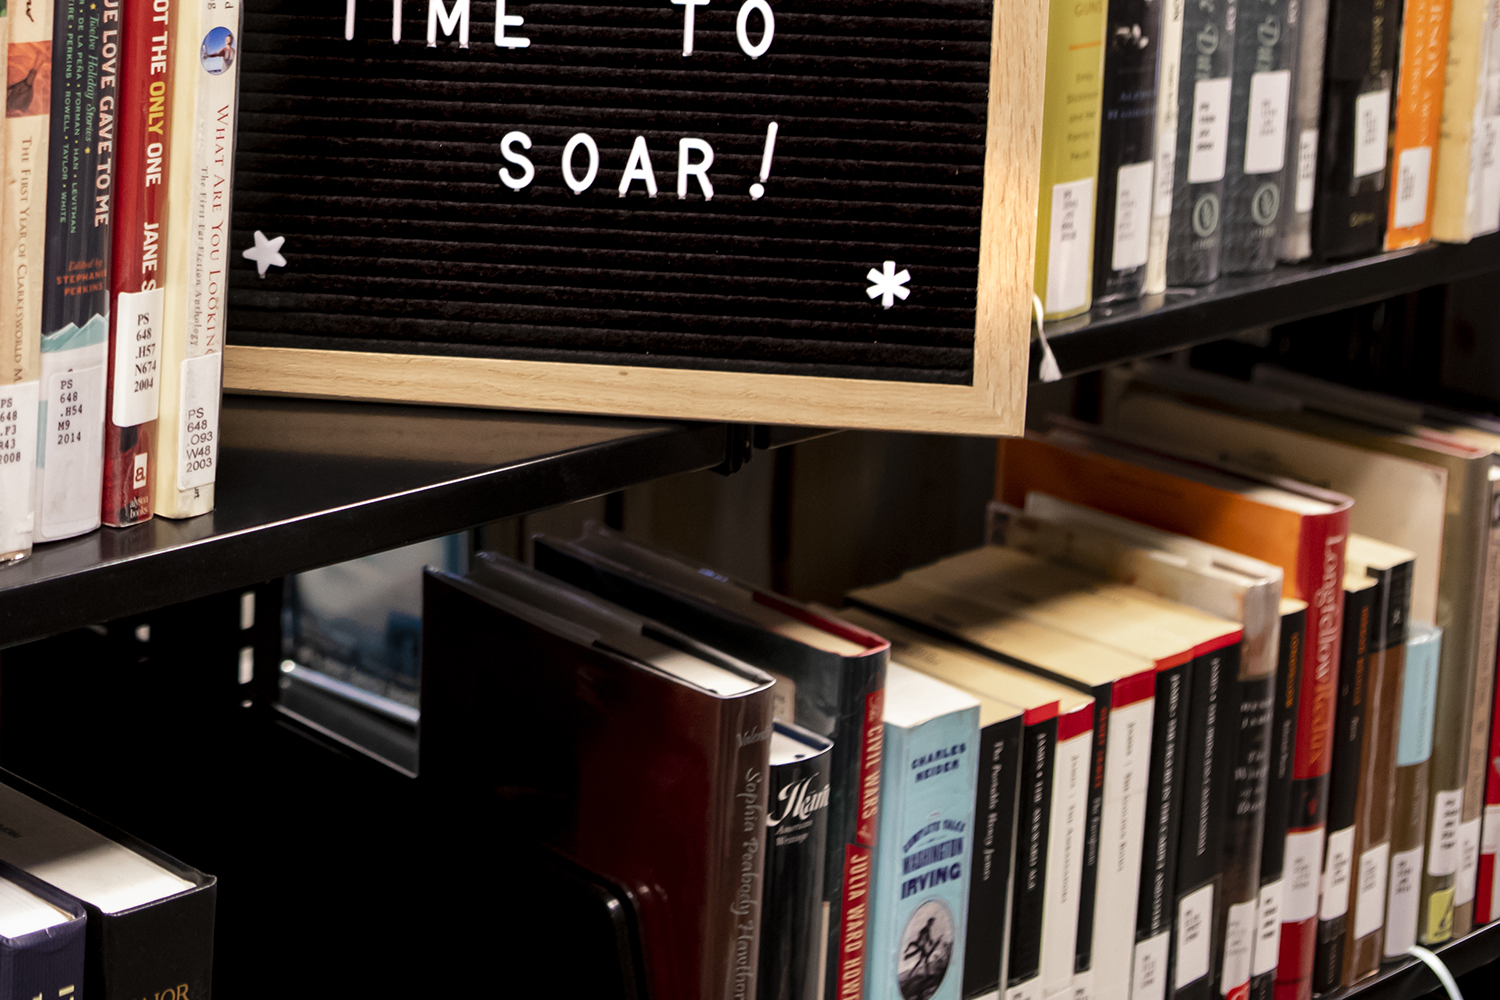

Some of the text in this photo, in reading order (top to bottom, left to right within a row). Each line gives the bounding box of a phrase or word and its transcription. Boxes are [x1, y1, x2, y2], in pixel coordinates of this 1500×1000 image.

[77, 17, 84, 31] DE
[65, 33, 74, 78] PERKINS
[77, 35, 84, 49] LA
[150, 31, 167, 75] THE
[76, 52, 84, 81] PEÑA
[100, 29, 117, 89] LOVE
[84, 13, 100, 142] Twelve Holiday Stories
[63, 91, 71, 133] ROWELL
[148, 81, 165, 135] ONLY
[97, 95, 115, 155] GAVE
[214, 104, 229, 166] WHAT
[61, 144, 69, 180] TAYLOR
[96, 160, 111, 190] TO
[145, 142, 163, 187] ONE
[498, 121, 779, 201] SOAR!
[70, 182, 78, 234] LEVITHAN
[212, 174, 226, 213] ARE
[94, 194, 109, 228] ME
[13, 136, 32, 363] THE FIRST YEAR OF CLARKESWORLD
[141, 222, 159, 275] JANE
[209, 218, 224, 261] YOU
[189, 166, 209, 347] The First Fat Fiction Anthology
[137, 313, 150, 325] PS
[136, 328, 152, 341] 648
[135, 343, 156, 359] .H57
[135, 359, 156, 376] N674
[60, 379, 73, 389] PS
[60, 391, 78, 403] 648
[134, 377, 154, 392] 2004
[0, 398, 12, 408] PS
[0, 411, 18, 421] 648
[60, 405, 83, 417] .H54
[188, 407, 205, 419] PS
[0, 425, 17, 436] .F3
[57, 432, 81, 445] 2014
[58, 420, 70, 431] M9
[187, 420, 208, 433] 648
[186, 446, 211, 460] W48
[186, 458, 212, 473] 2003
[911, 743, 967, 771] CHARLES
[861, 725, 884, 820] CIVIL WARS
[901, 862, 962, 901] IRVING
[845, 854, 868, 954] JULIA WARD
